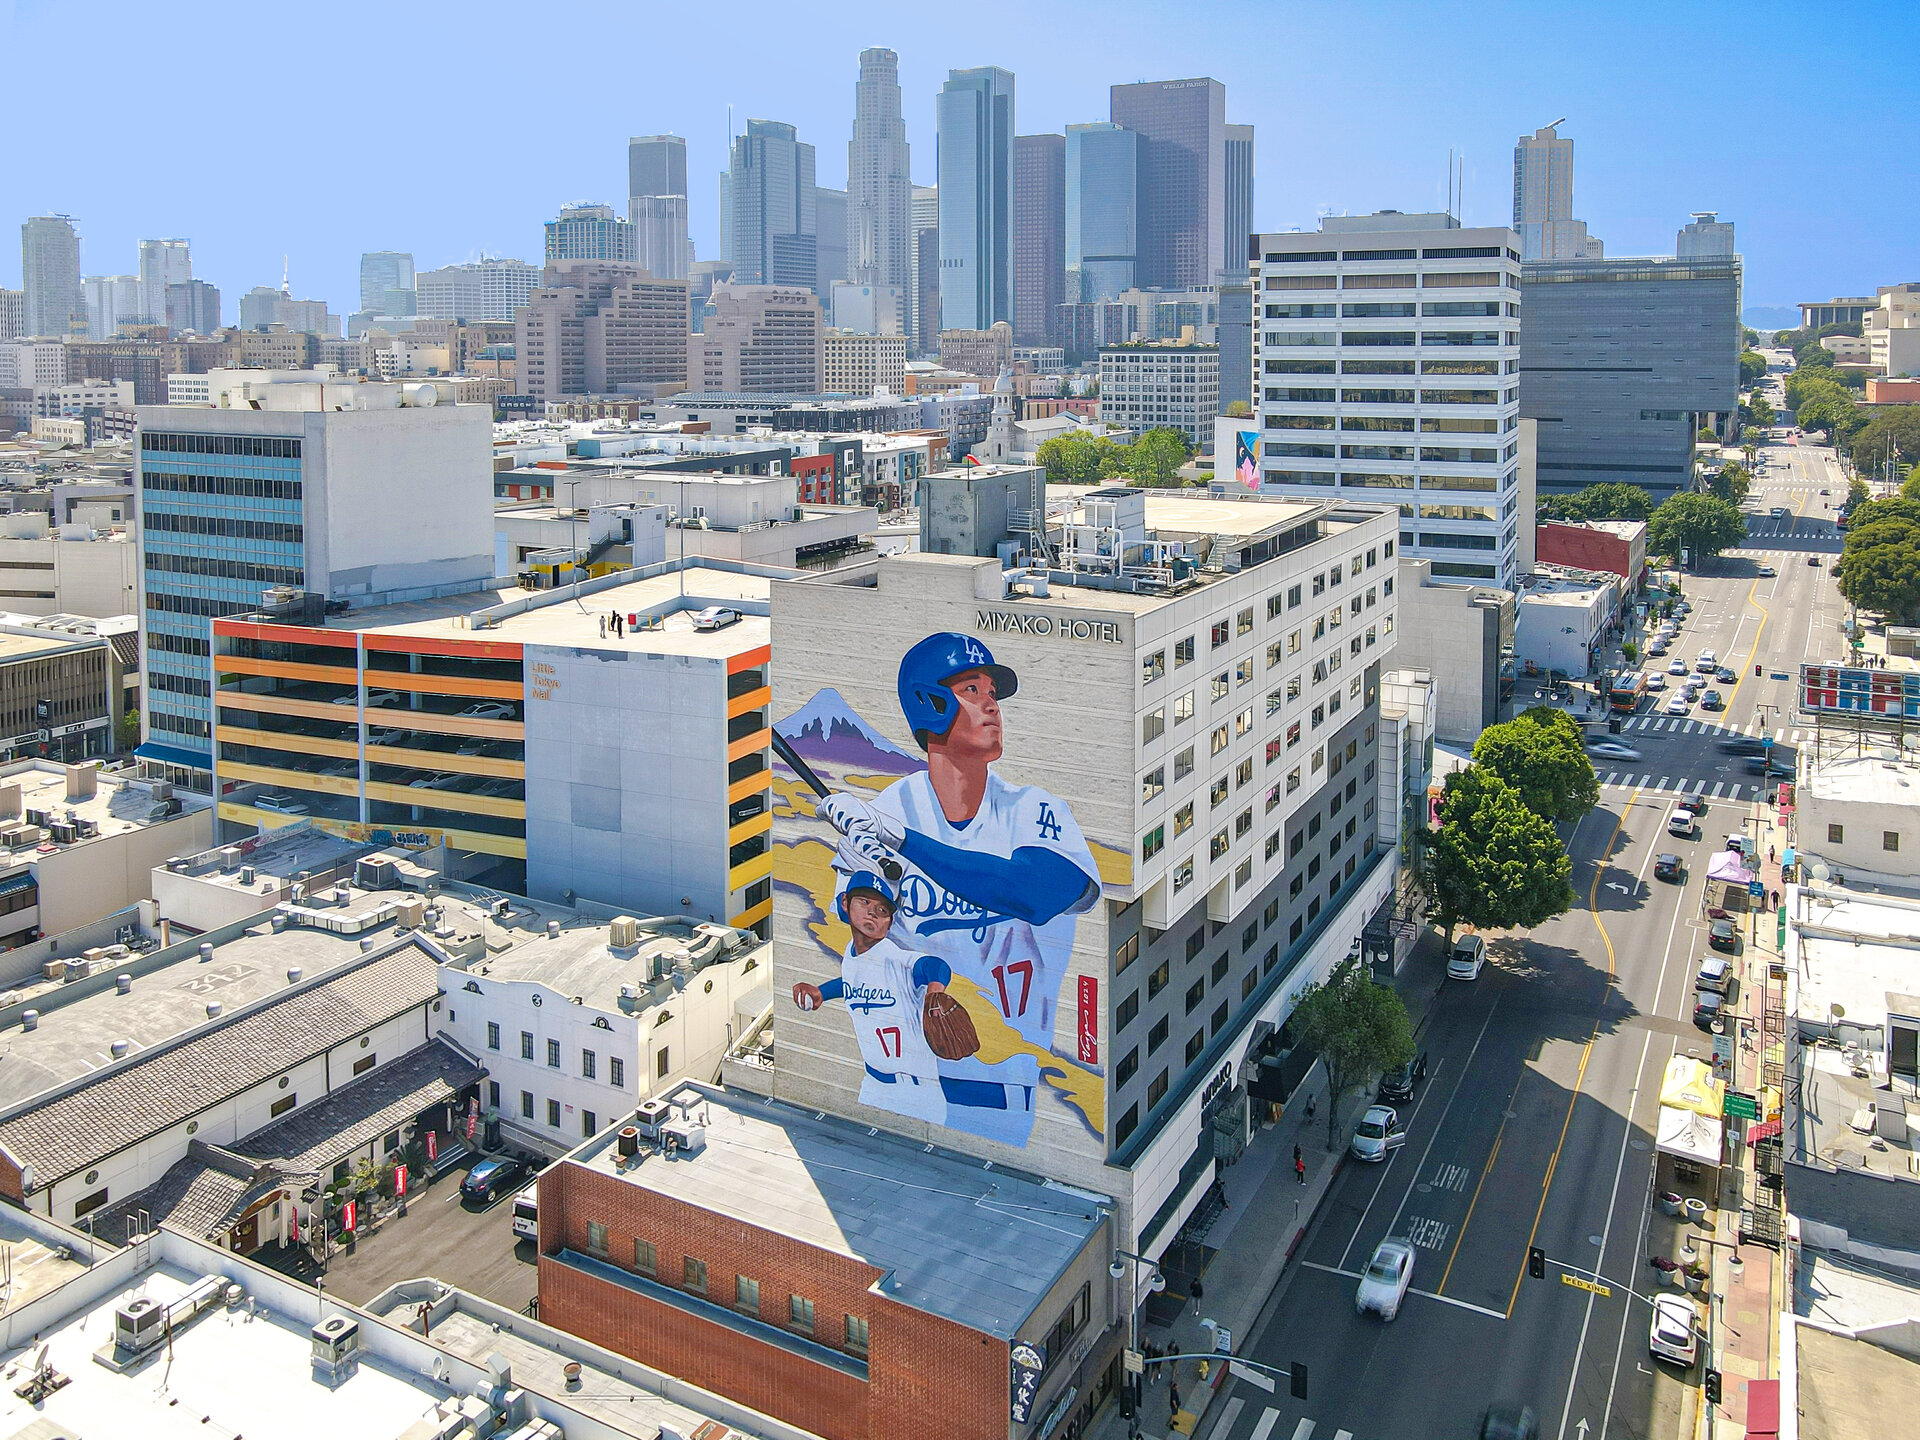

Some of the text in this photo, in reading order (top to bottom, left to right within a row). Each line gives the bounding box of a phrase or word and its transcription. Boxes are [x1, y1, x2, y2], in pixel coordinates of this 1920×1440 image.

[975, 610, 1122, 644] MIYAKO HOTEL
[962, 635, 985, 664] LA
[530, 661, 555, 675] Little
[531, 674, 561, 688] Tokyo
[530, 688, 552, 700] Mall
[1036, 801, 1062, 842] LA
[872, 876, 882, 892] LA
[181, 964, 257, 993] 342
[991, 959, 1034, 1019] 17
[842, 981, 896, 1015] Dodgers
[875, 1026, 901, 1058] 17
[1565, 1276, 1607, 1294] PED XING
[1012, 1370, 1036, 1422] 文化堂
